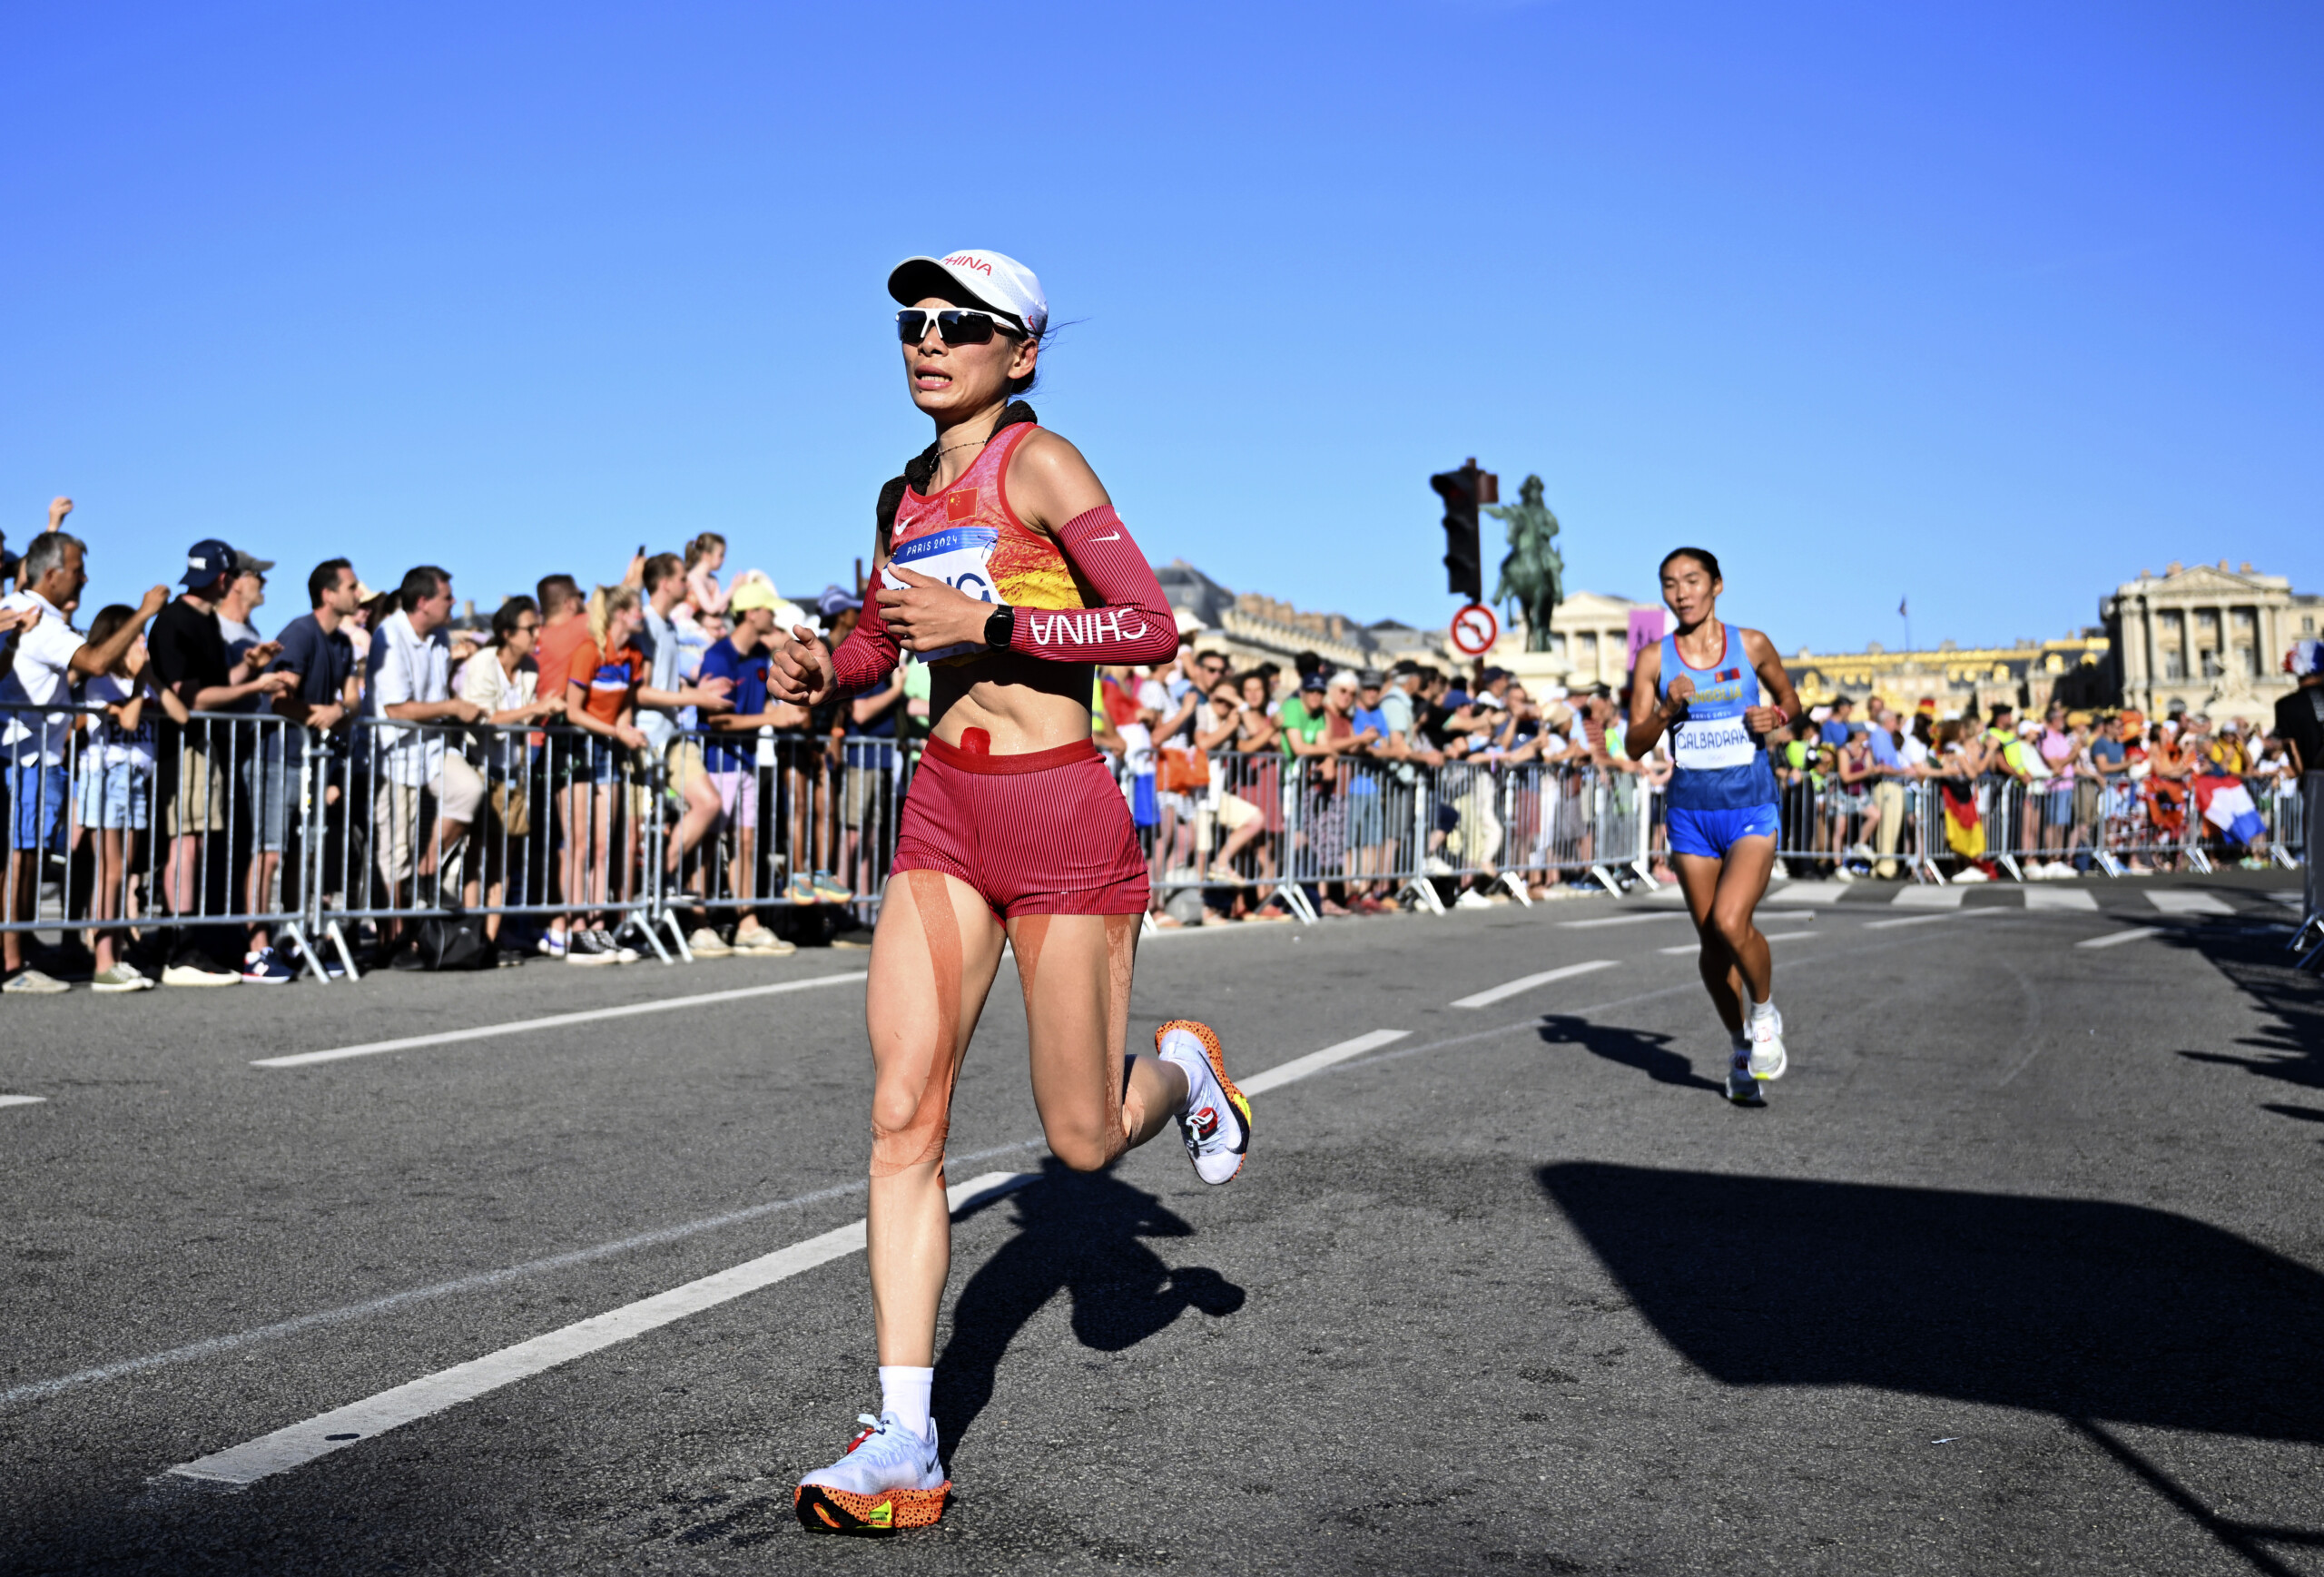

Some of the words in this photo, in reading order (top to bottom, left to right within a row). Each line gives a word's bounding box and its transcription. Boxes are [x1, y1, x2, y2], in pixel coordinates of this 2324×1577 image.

[933, 534, 958, 549] 2024
[1029, 607, 1147, 646] CHINA
[1686, 685, 1742, 705] ONGOLIA
